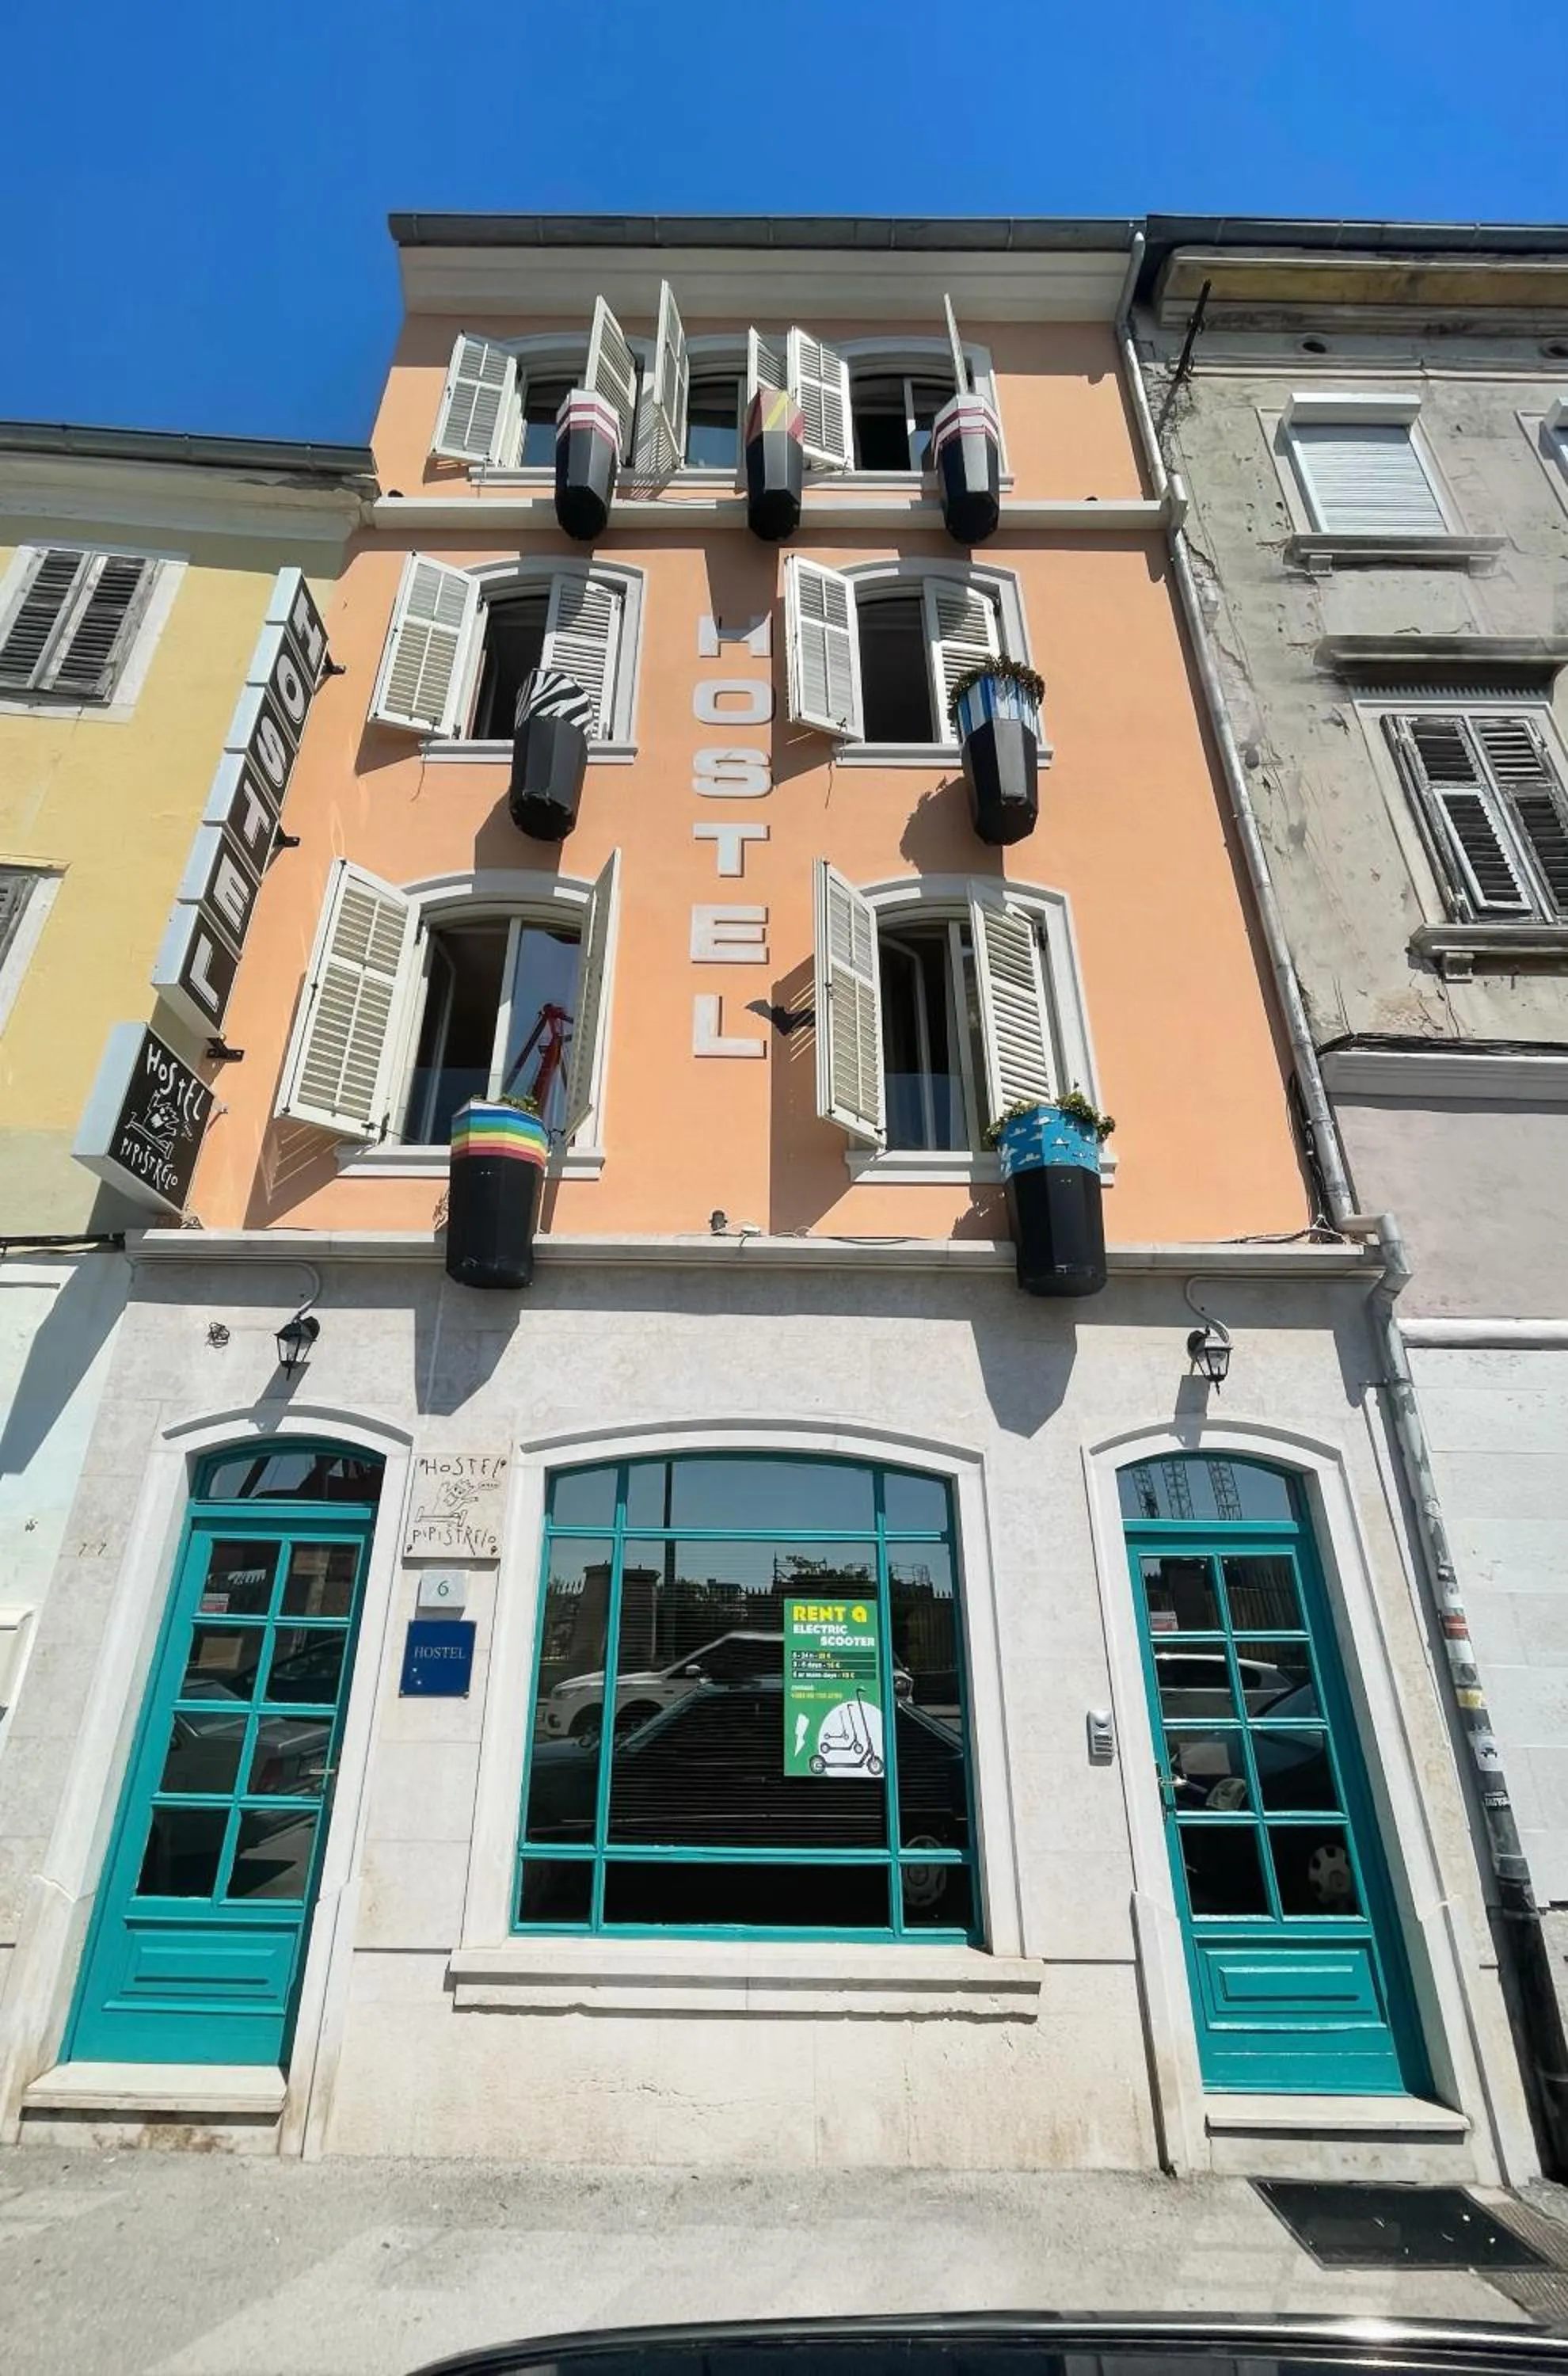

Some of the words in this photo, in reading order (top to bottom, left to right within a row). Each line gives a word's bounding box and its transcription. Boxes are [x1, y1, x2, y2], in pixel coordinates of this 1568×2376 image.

[190, 592, 322, 1014] HOSTEL
[691, 614, 774, 1058] HOSTEL
[436, 1579, 450, 1597] 6
[793, 1605, 847, 1623] RENT
[793, 1624, 848, 1635] ELECTRIC
[820, 1635, 876, 1647] SCOOTER
[413, 1646, 467, 1660] HOSTEL
